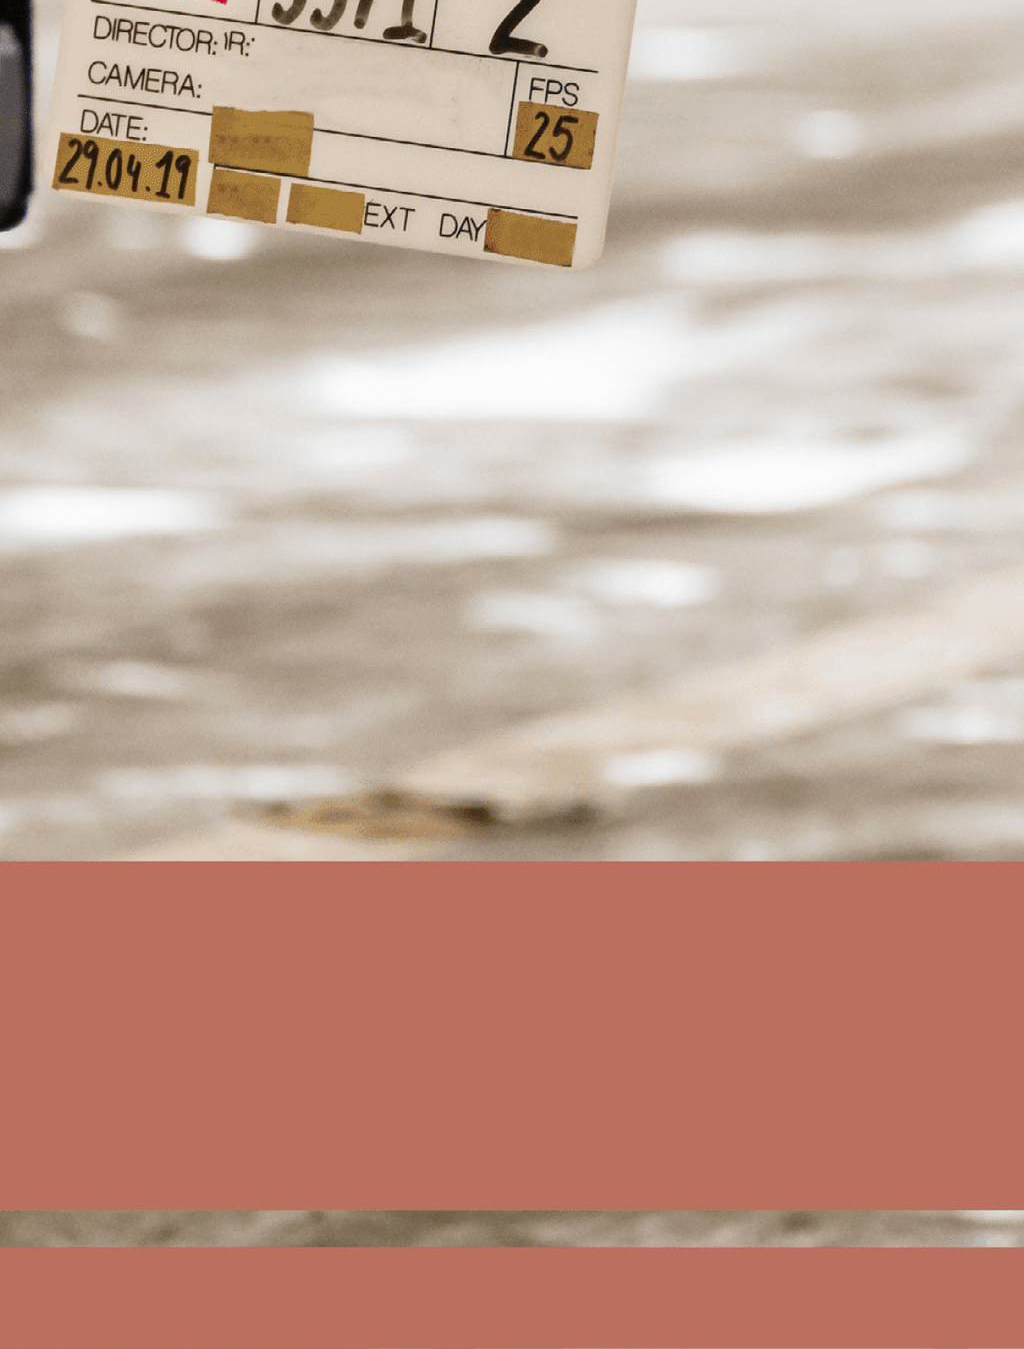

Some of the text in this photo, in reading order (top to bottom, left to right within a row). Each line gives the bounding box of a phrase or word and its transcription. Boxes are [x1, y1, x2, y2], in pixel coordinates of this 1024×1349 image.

[93, 15, 218, 55] DIRECTOR:
[88, 60, 202, 98] CAMERA:
[529, 77, 580, 107] FPS
[80, 109, 148, 141] DATE:
[524, 111, 579, 162] 25
[58, 138, 192, 200] 29.04.19
[363, 201, 487, 242] EXT DAY
